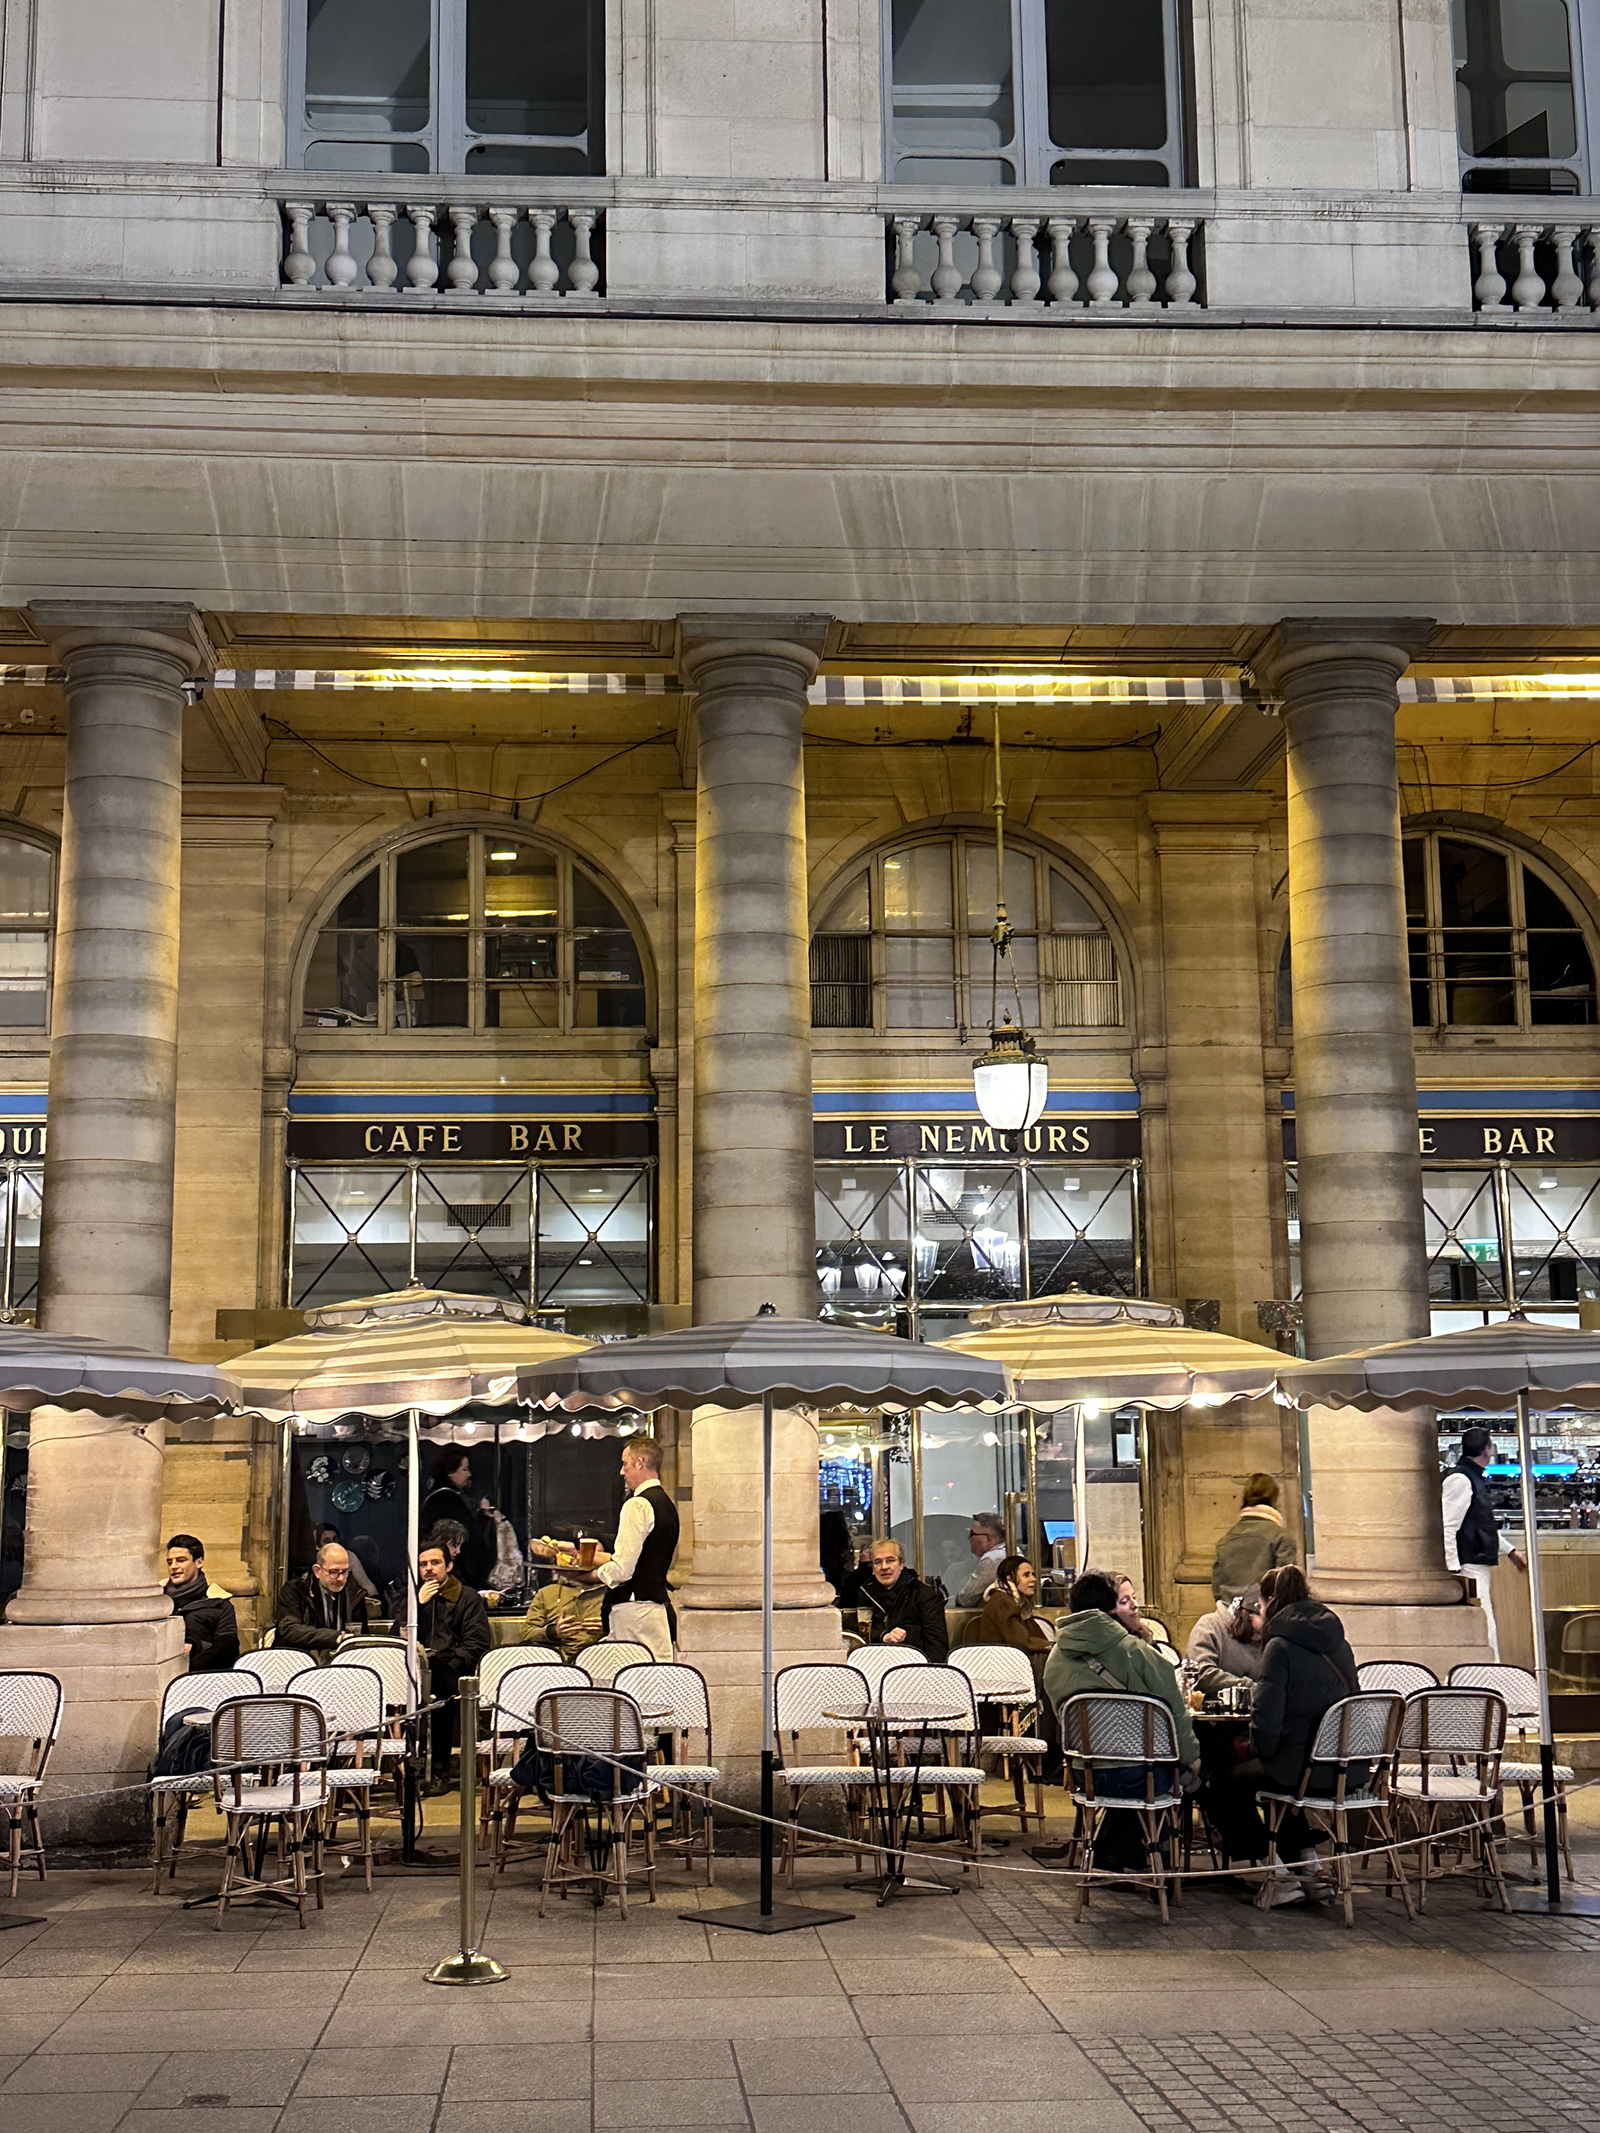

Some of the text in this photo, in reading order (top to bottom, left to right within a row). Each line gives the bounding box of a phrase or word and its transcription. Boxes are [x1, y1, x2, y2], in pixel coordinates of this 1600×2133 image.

[365, 1124, 584, 1153] CAFE BAR
[844, 1125, 890, 1153] LE
[1482, 1127, 1556, 1155] BAR
